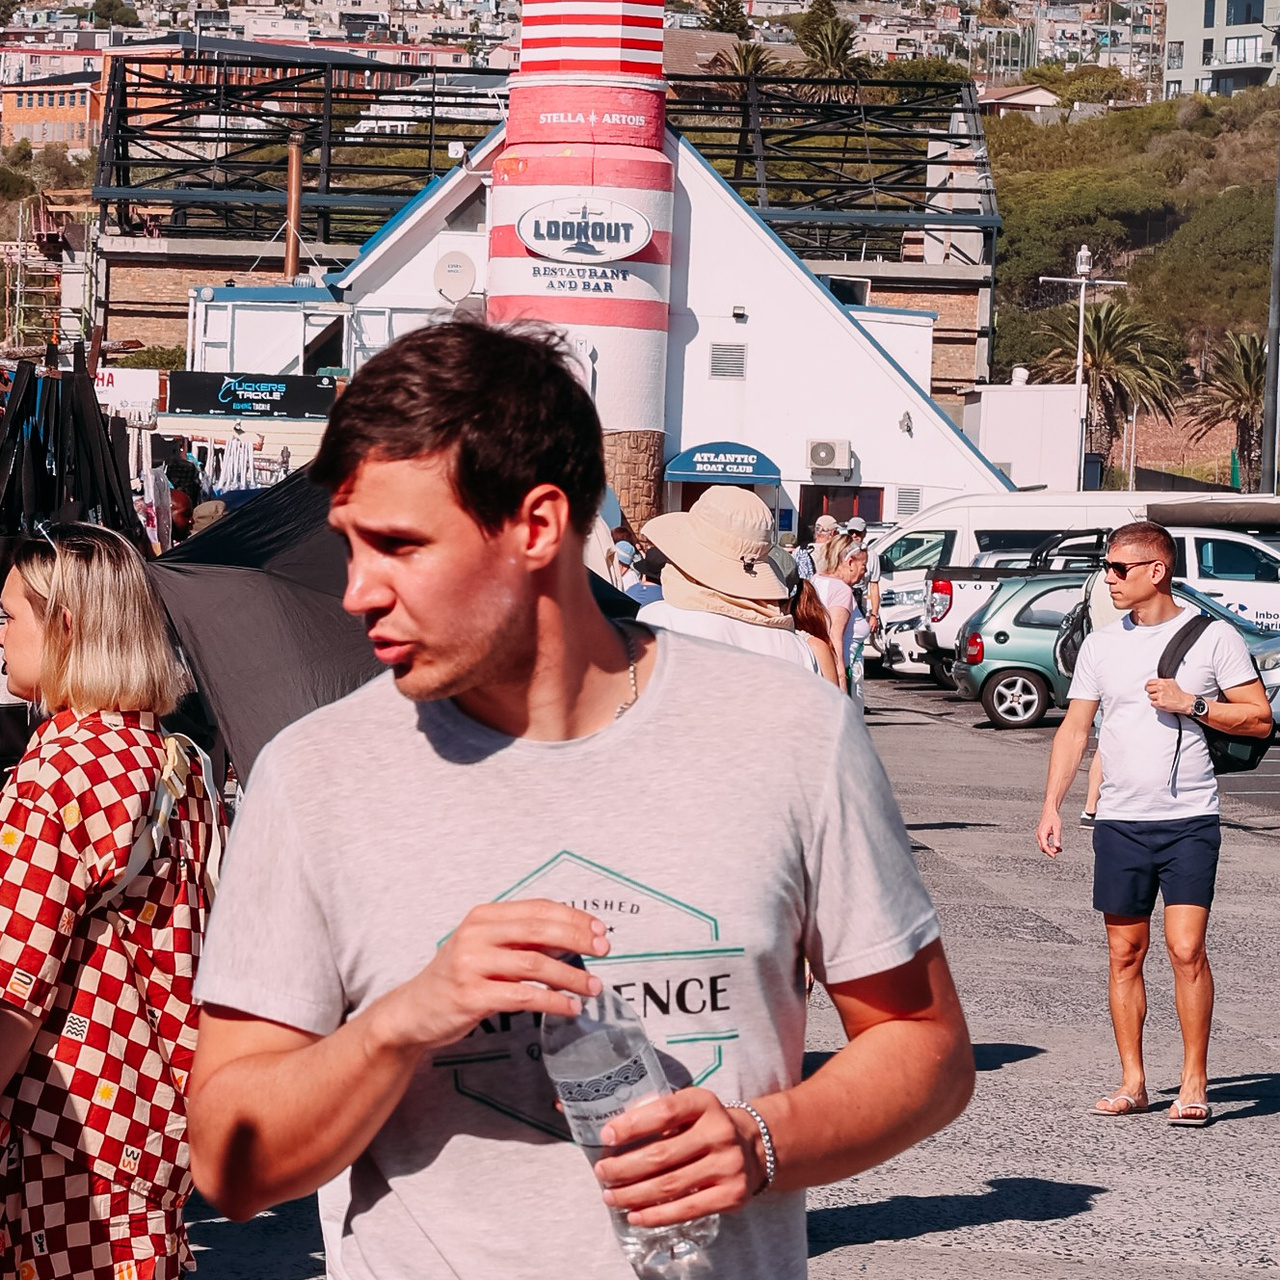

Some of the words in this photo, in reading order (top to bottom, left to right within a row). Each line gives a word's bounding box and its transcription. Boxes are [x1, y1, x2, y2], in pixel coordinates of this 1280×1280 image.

[539, 113, 585, 124] STELLA
[602, 113, 646, 126] ARTOIS
[533, 220, 634, 243] LOOKOUT
[532, 266, 630, 281] RESTAURANT
[546, 280, 578, 291] AND
[582, 281, 614, 293] BAR
[236, 391, 281, 400] TACKLE
[692, 452, 757, 464] ATLANTIC
[696, 463, 724, 472] BOAT
[726, 464, 754, 473] CLUB
